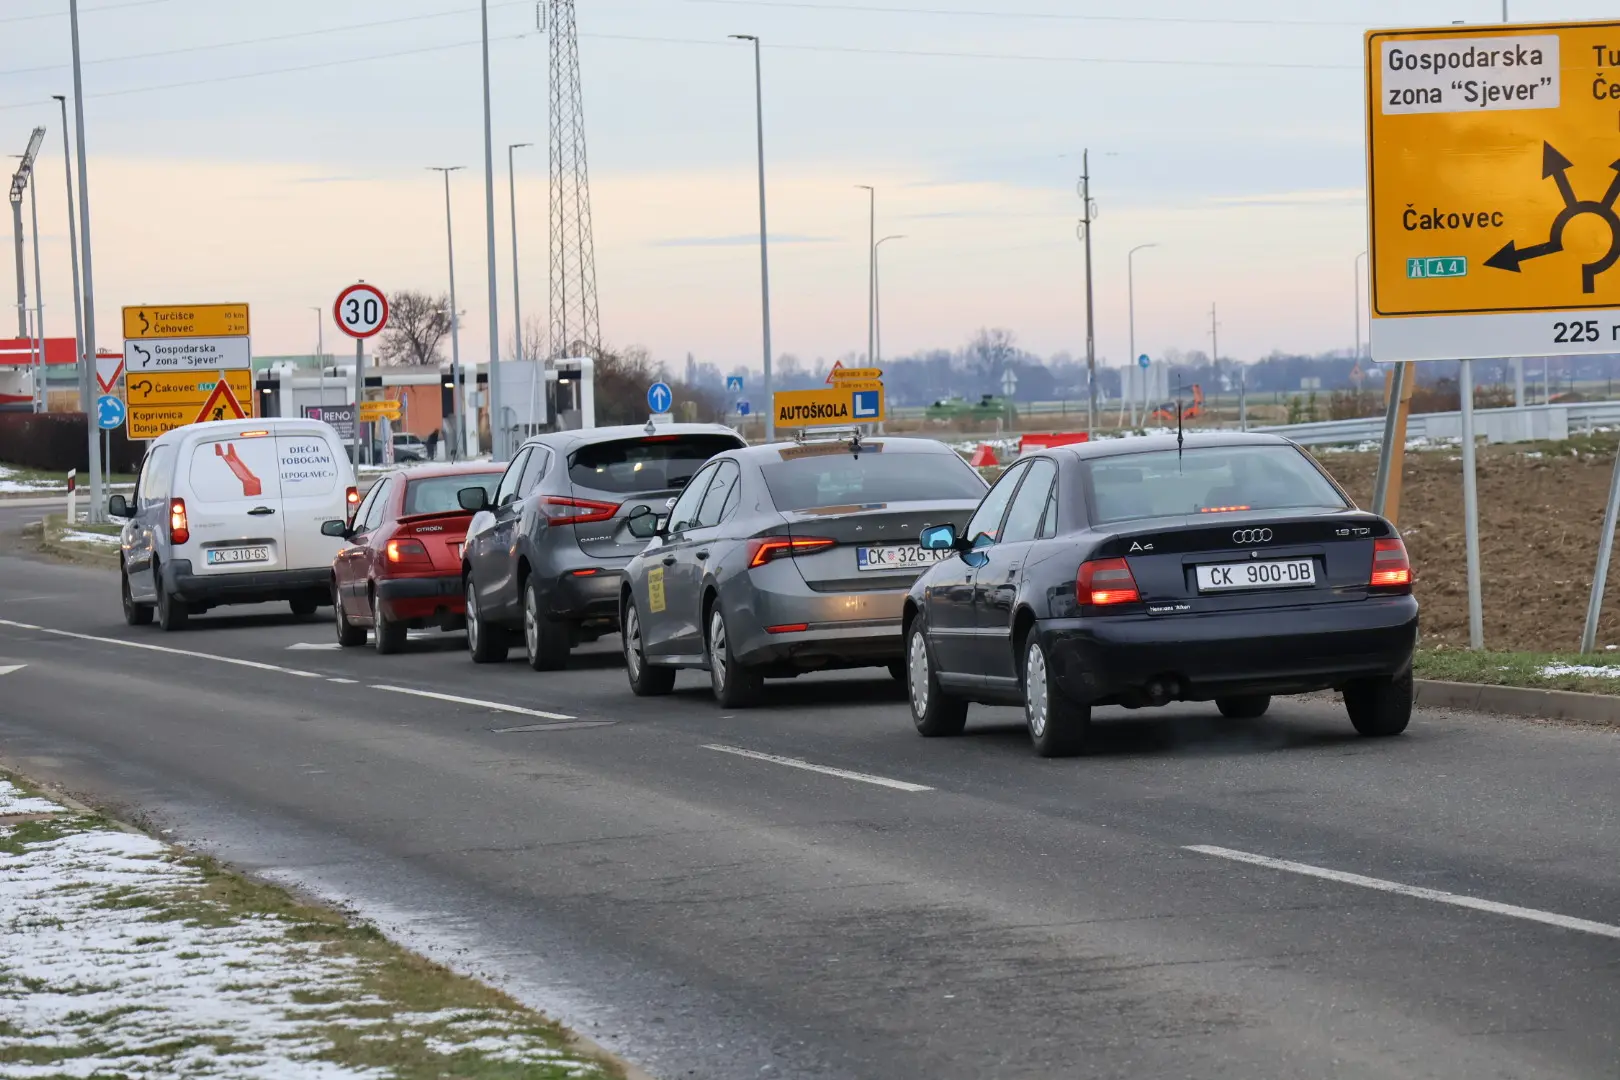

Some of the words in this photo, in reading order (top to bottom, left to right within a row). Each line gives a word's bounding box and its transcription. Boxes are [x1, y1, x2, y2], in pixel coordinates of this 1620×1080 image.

[1388, 44, 1543, 74] Gospodarska
[1389, 86, 1443, 105] zona
[1402, 203, 1504, 231] Čakovec
[346, 298, 378, 325] 30
[154, 322, 194, 333] Čehovec
[1553, 320, 1600, 343] 225
[155, 344, 216, 356] Gospodarska
[156, 357, 178, 365] zona
[155, 381, 195, 392] Čakovec
[780, 402, 848, 421] AUTOŠKOLA
[855, 394, 876, 416] L
[133, 411, 183, 422] Koprivnica
[133, 423, 158, 434] Donja
[281, 456, 330, 465] TOBOGANI
[214, 551, 226, 561] CK
[868, 548, 886, 565] CK
[1210, 567, 1234, 586] CK
[1246, 562, 1311, 583] 900-DB
